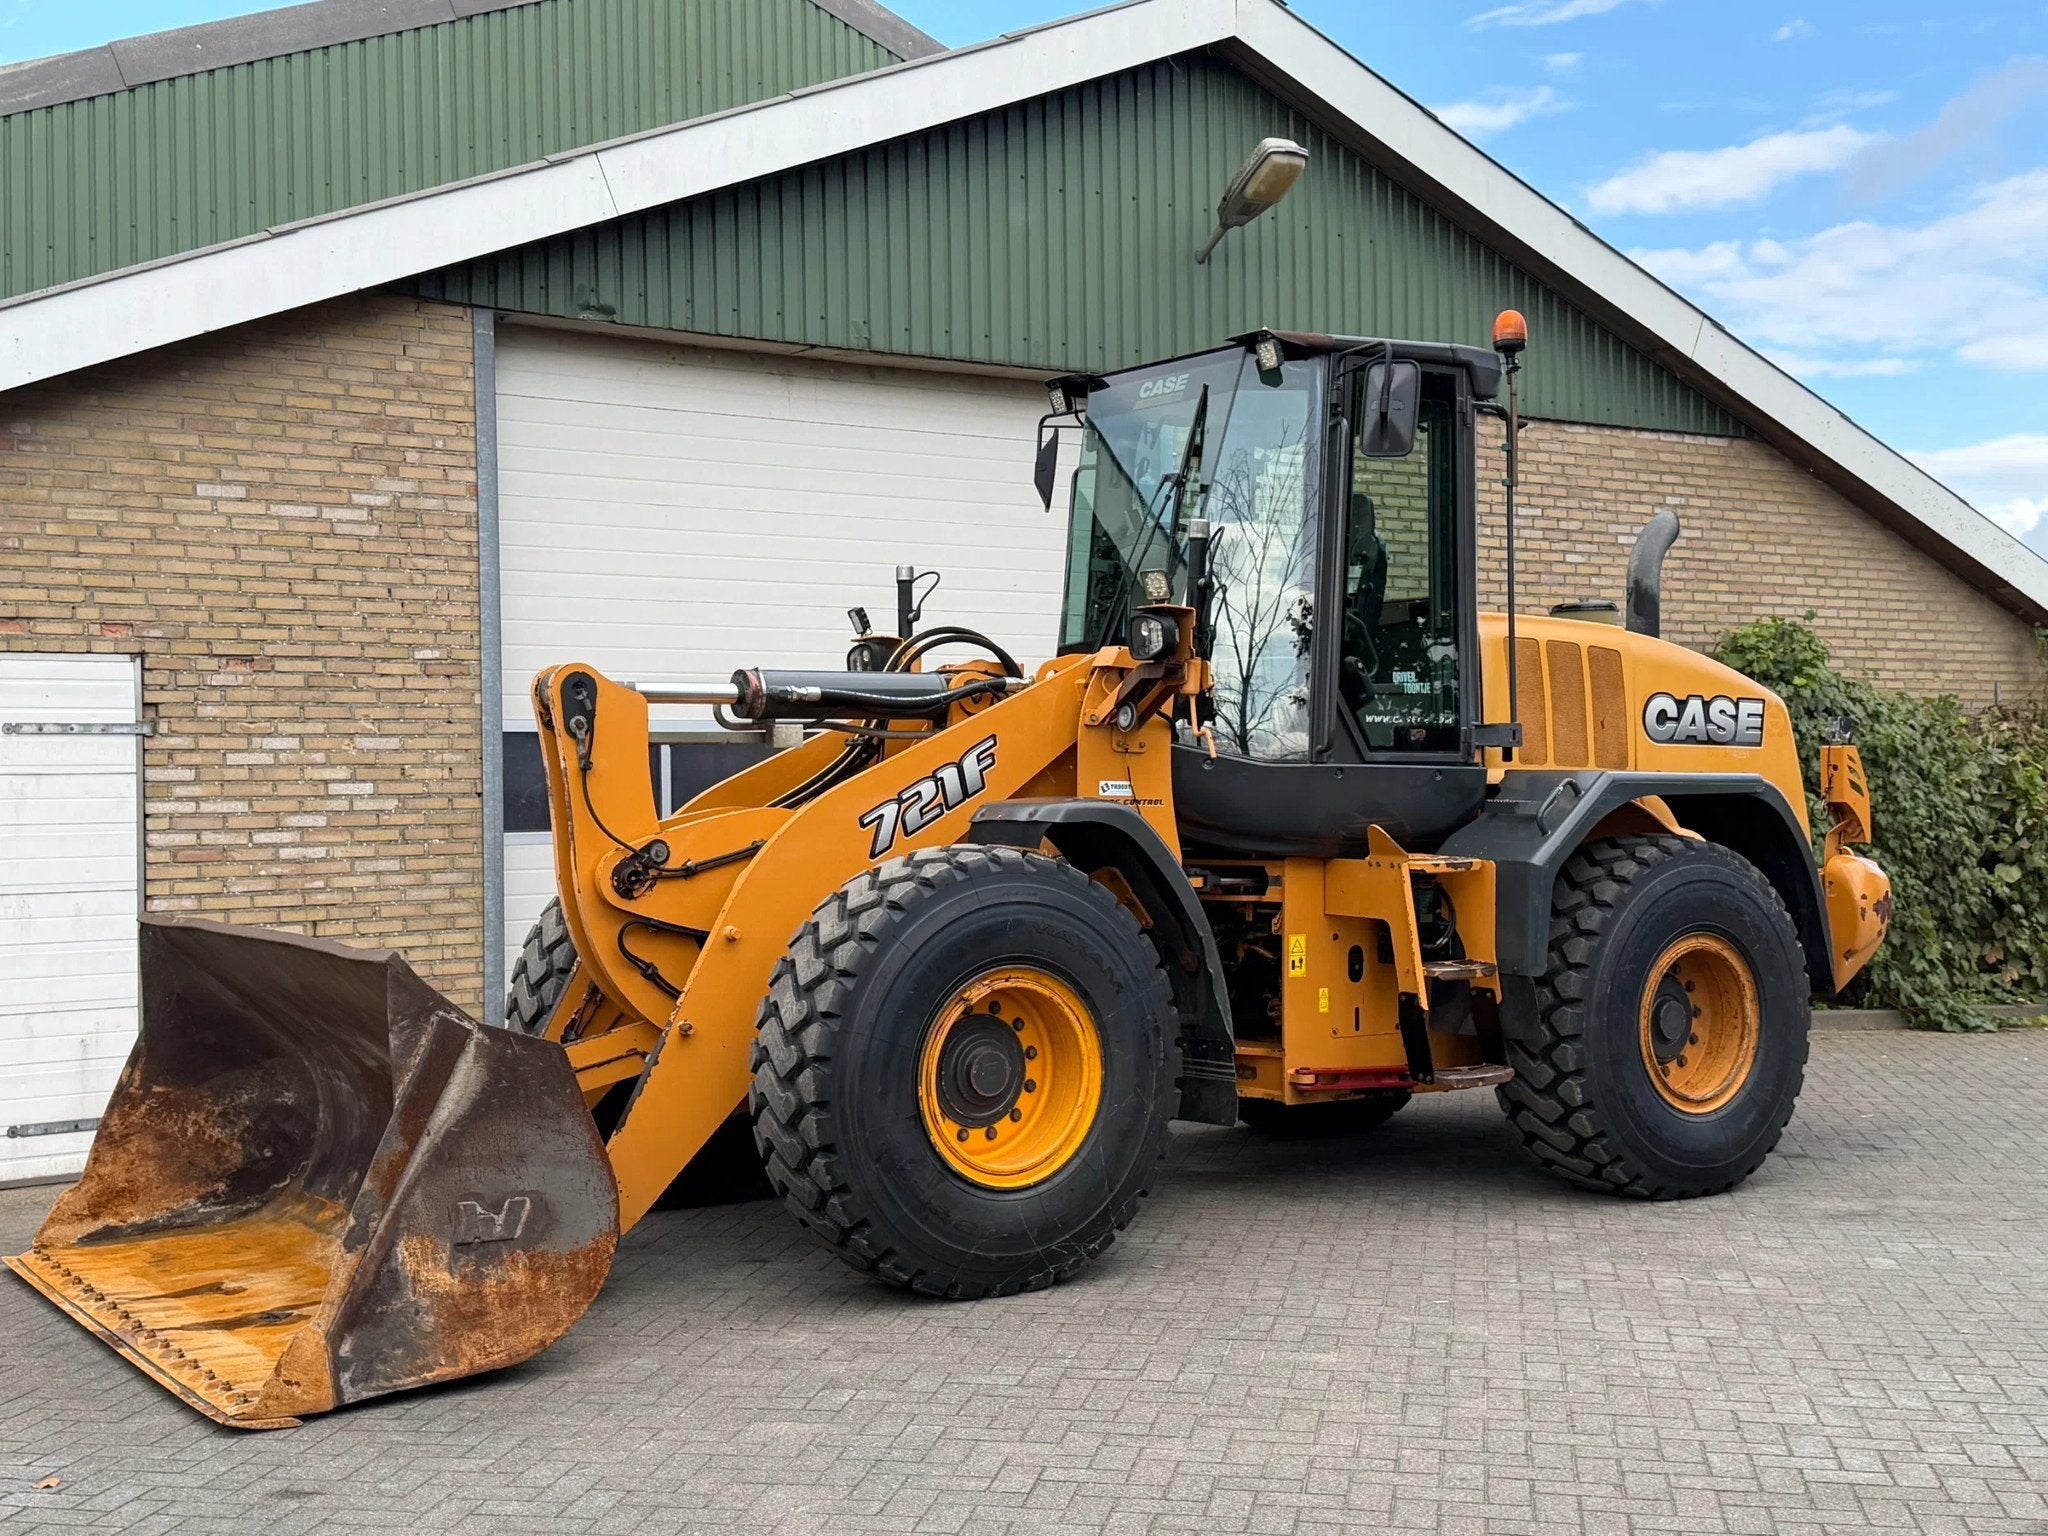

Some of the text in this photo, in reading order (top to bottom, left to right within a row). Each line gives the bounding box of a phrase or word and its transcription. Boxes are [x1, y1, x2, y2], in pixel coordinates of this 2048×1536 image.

[1138, 373, 1190, 398] CASE
[1643, 693, 1765, 745] CASE
[859, 733, 997, 859] 721F
[1123, 798, 1164, 806] CONTROL
